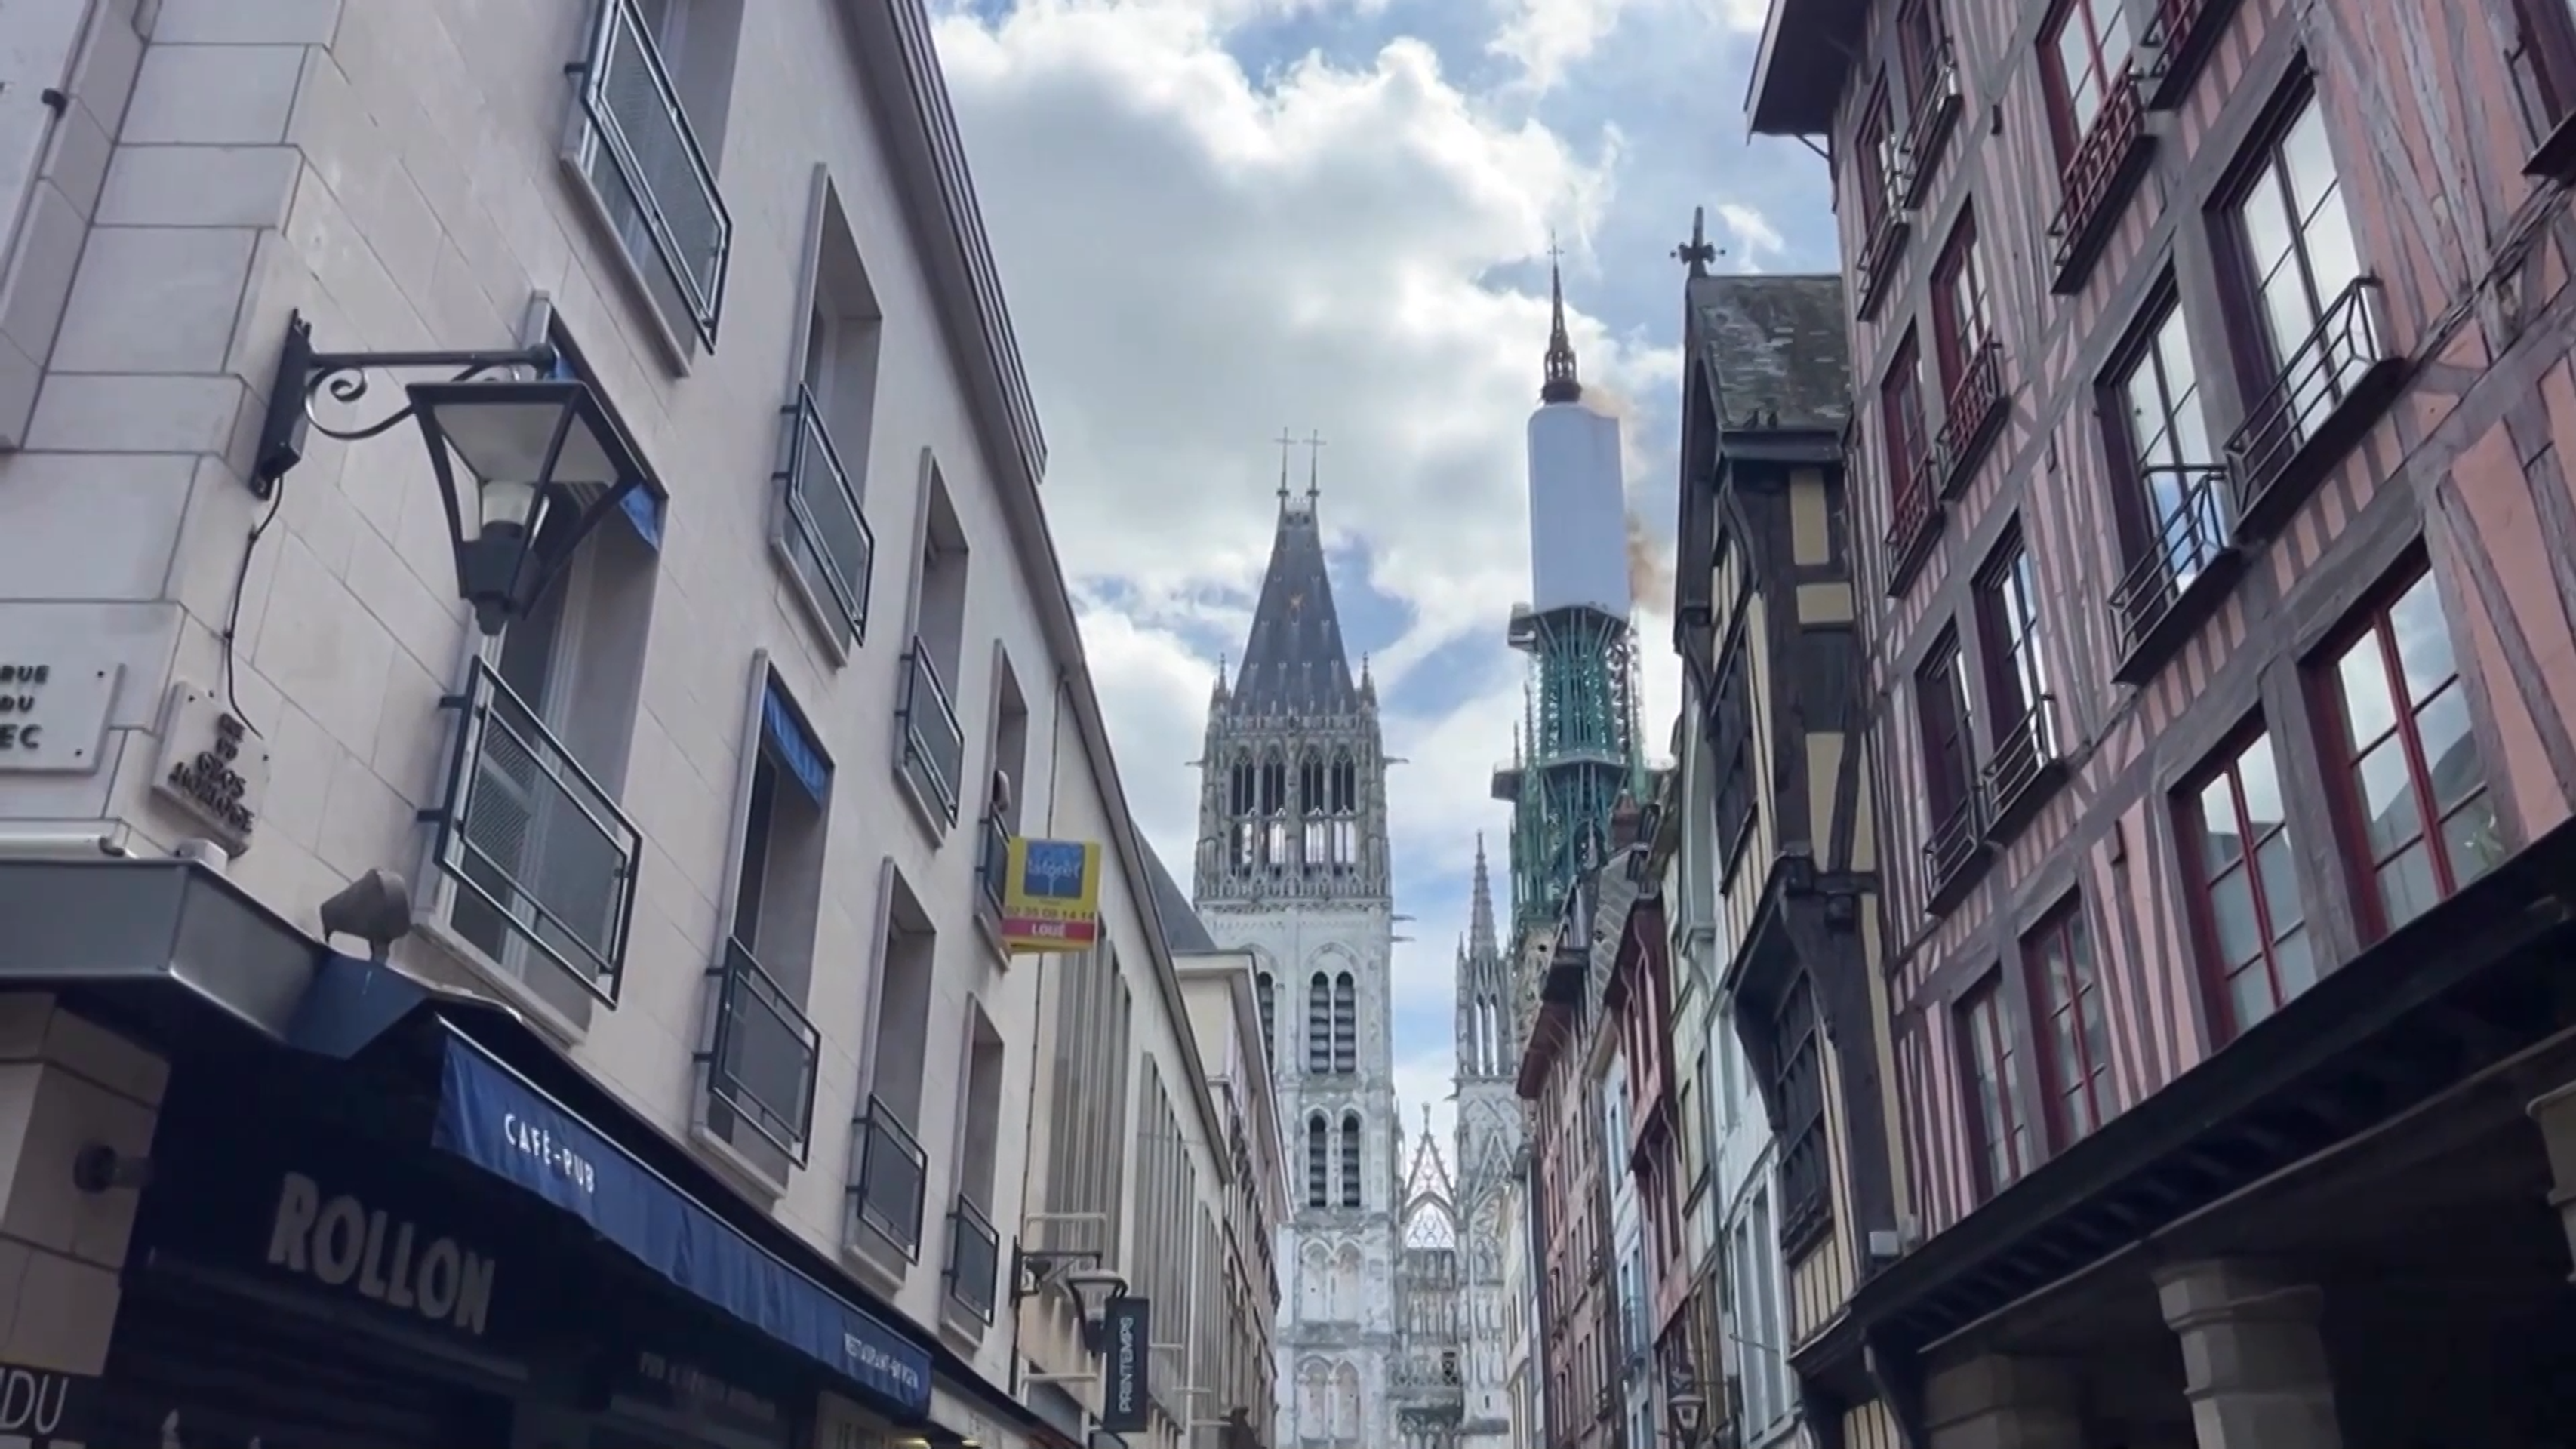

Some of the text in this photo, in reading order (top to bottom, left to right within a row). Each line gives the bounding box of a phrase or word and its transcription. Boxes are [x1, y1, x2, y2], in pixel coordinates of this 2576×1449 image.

[0, 664, 50, 685] RUE
[0, 694, 35, 714] DU
[268, 1171, 496, 1336] ROLLON
[1119, 1317, 1134, 1413] PRINTEMPS
[0, 1367, 69, 1434] DU
